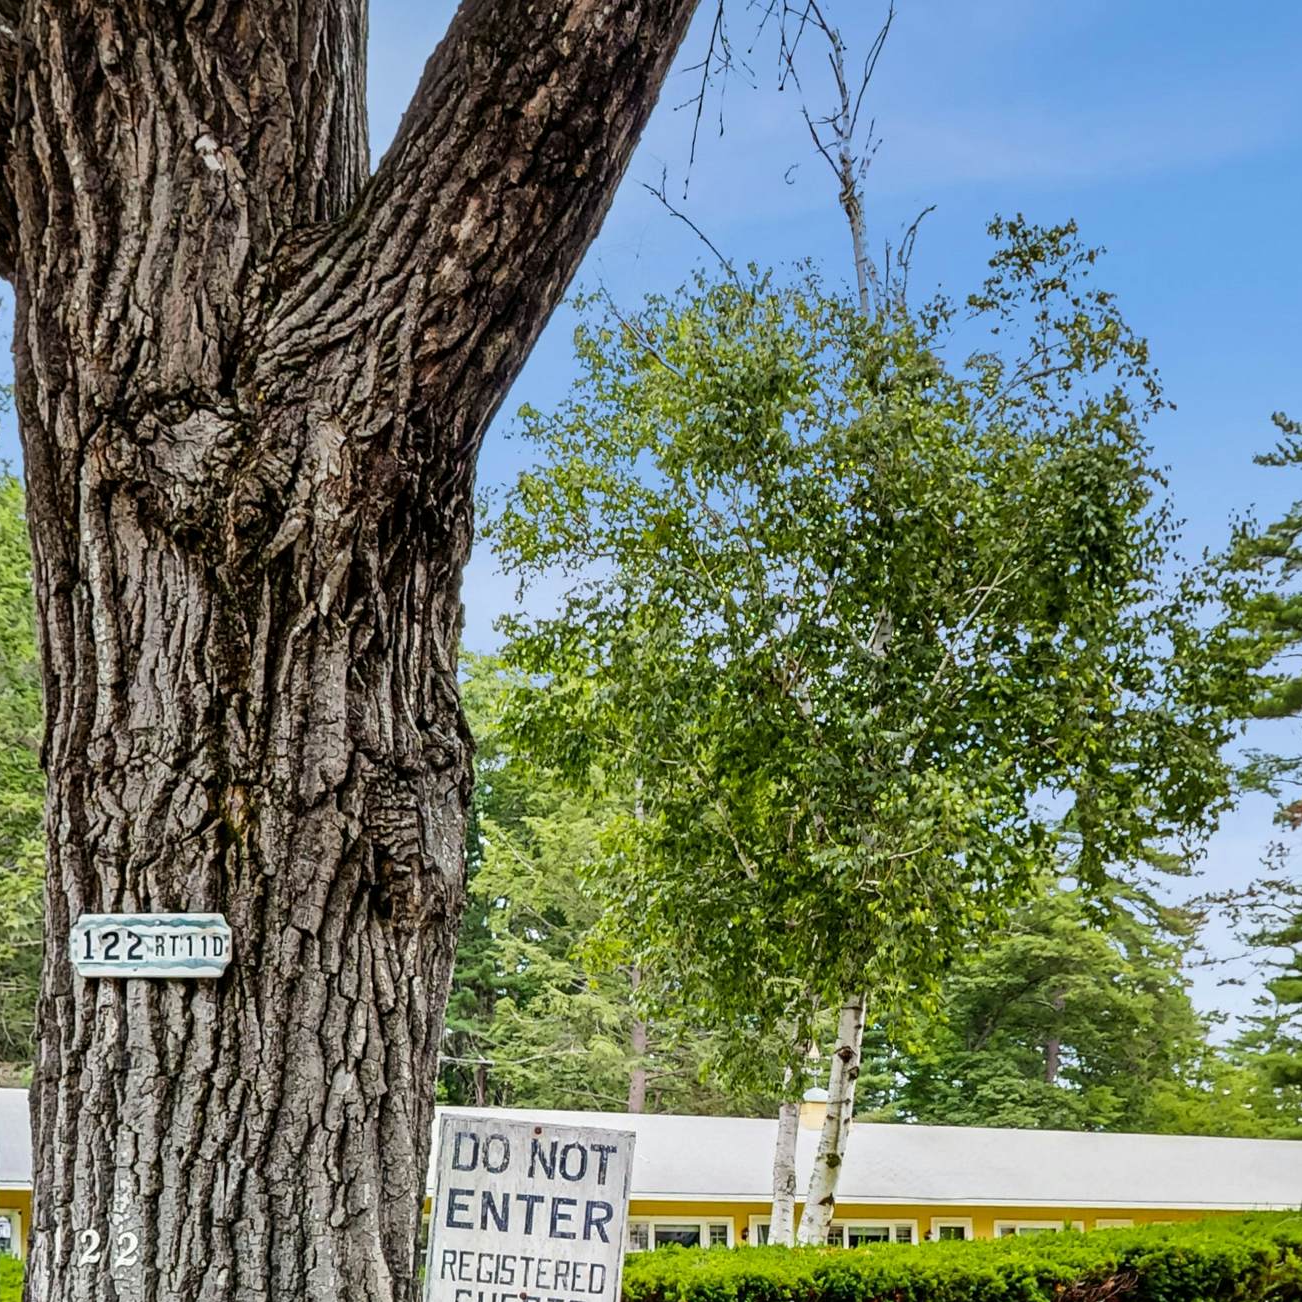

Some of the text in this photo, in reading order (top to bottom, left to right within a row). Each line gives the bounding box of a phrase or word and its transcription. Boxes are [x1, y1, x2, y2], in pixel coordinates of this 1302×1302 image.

[82, 929, 144, 961] 122
[451, 1131, 618, 1186] DO NOT
[445, 1187, 615, 1244] ENTER
[440, 1249, 607, 1295] REGISTERED
